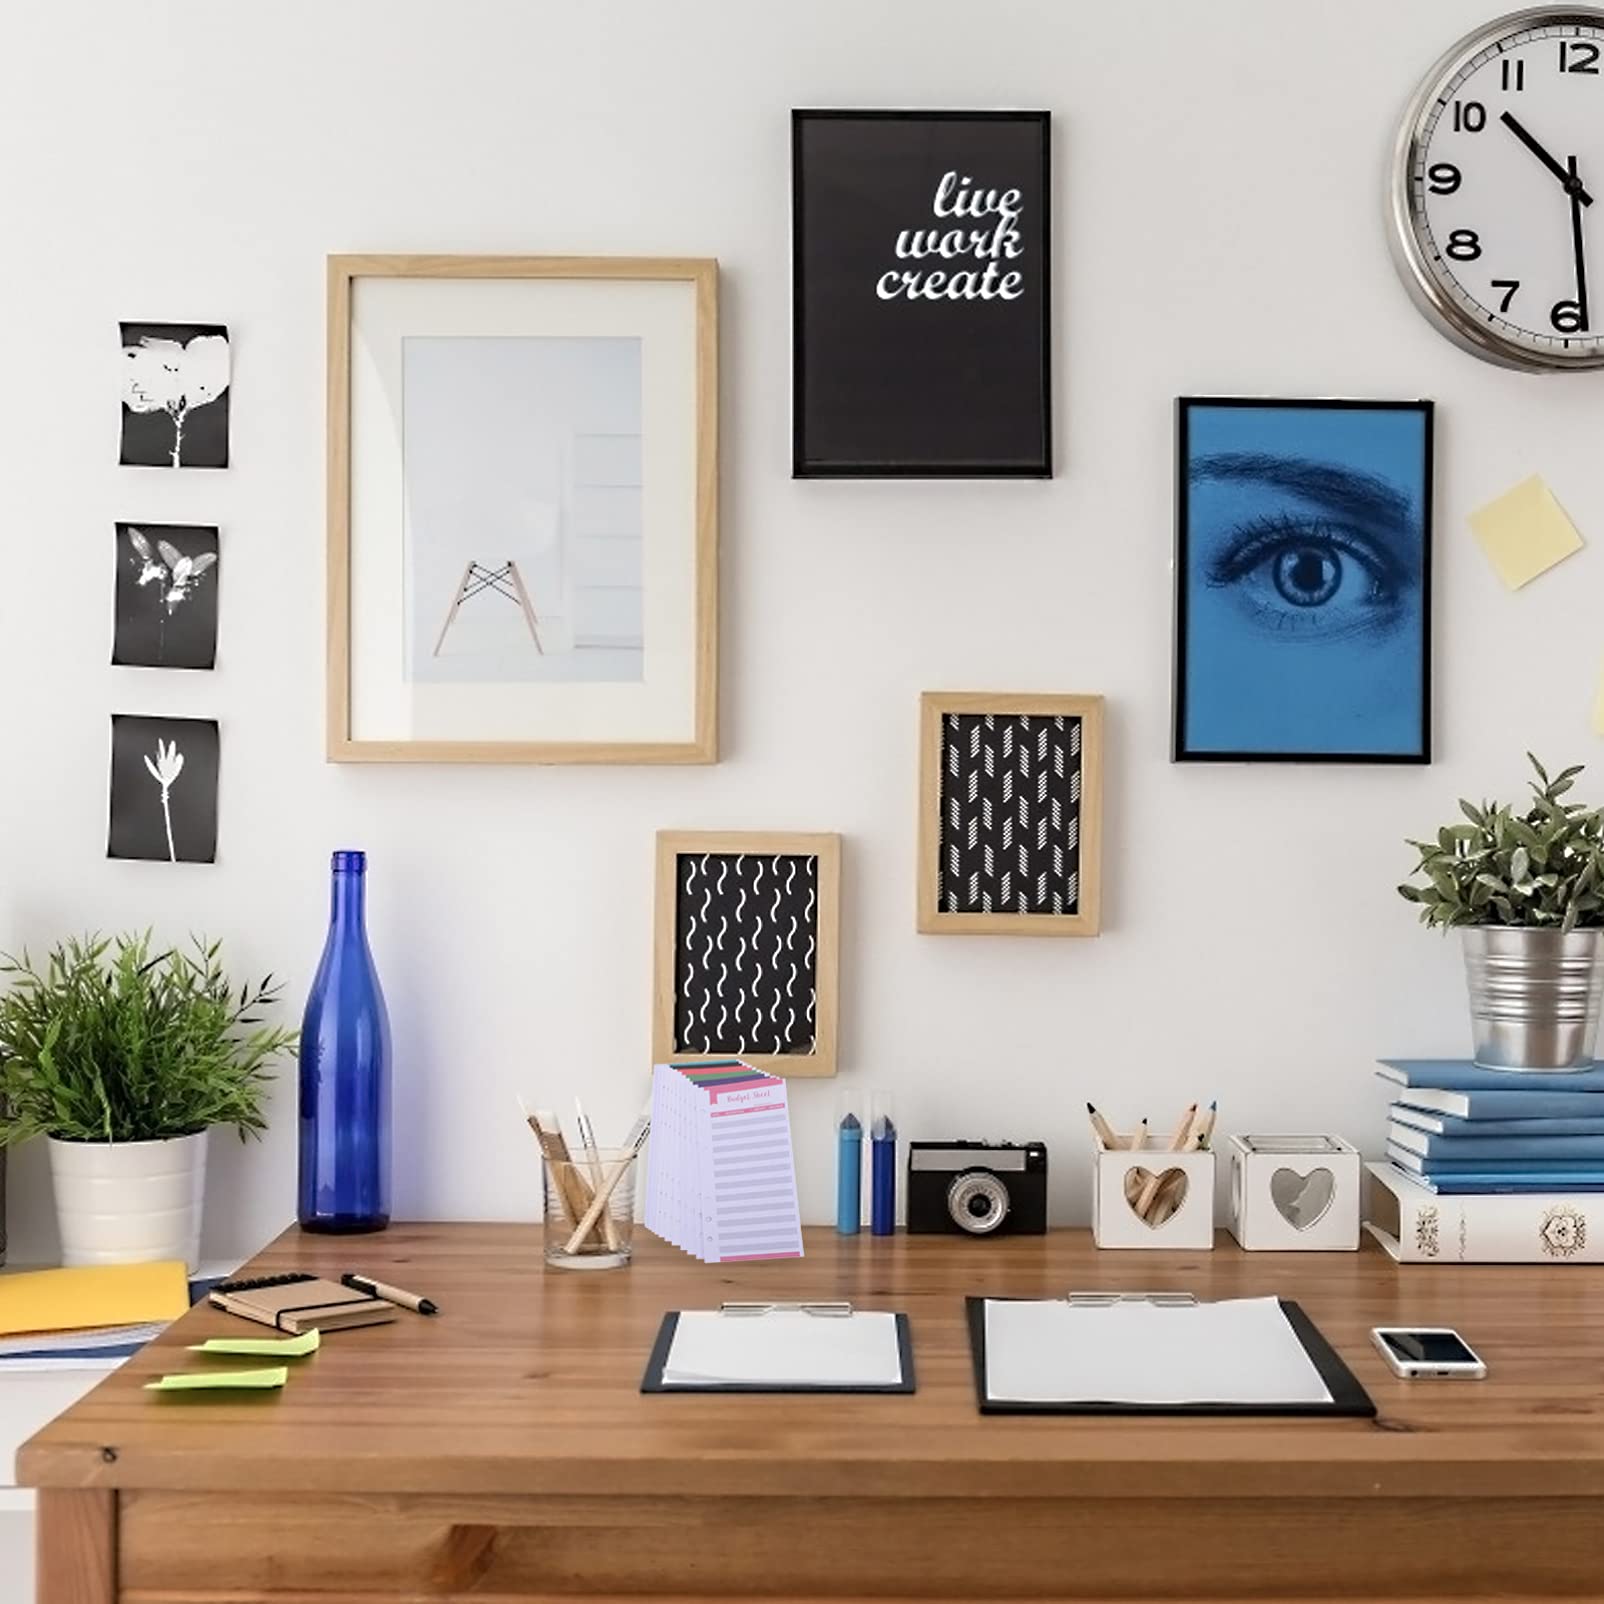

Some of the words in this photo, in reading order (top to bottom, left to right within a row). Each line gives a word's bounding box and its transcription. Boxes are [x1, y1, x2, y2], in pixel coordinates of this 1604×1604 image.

[1559, 41, 1600, 74] 12
[1502, 59, 1524, 91] 11
[1453, 100, 1487, 133] 10
[933, 170, 1024, 218] live
[1428, 163, 1462, 196] 9
[895, 213, 1025, 259] work
[1445, 229, 1482, 262] 8
[876, 261, 1025, 300] create
[1491, 280, 1520, 313] 7
[1550, 300, 1584, 333] 6
